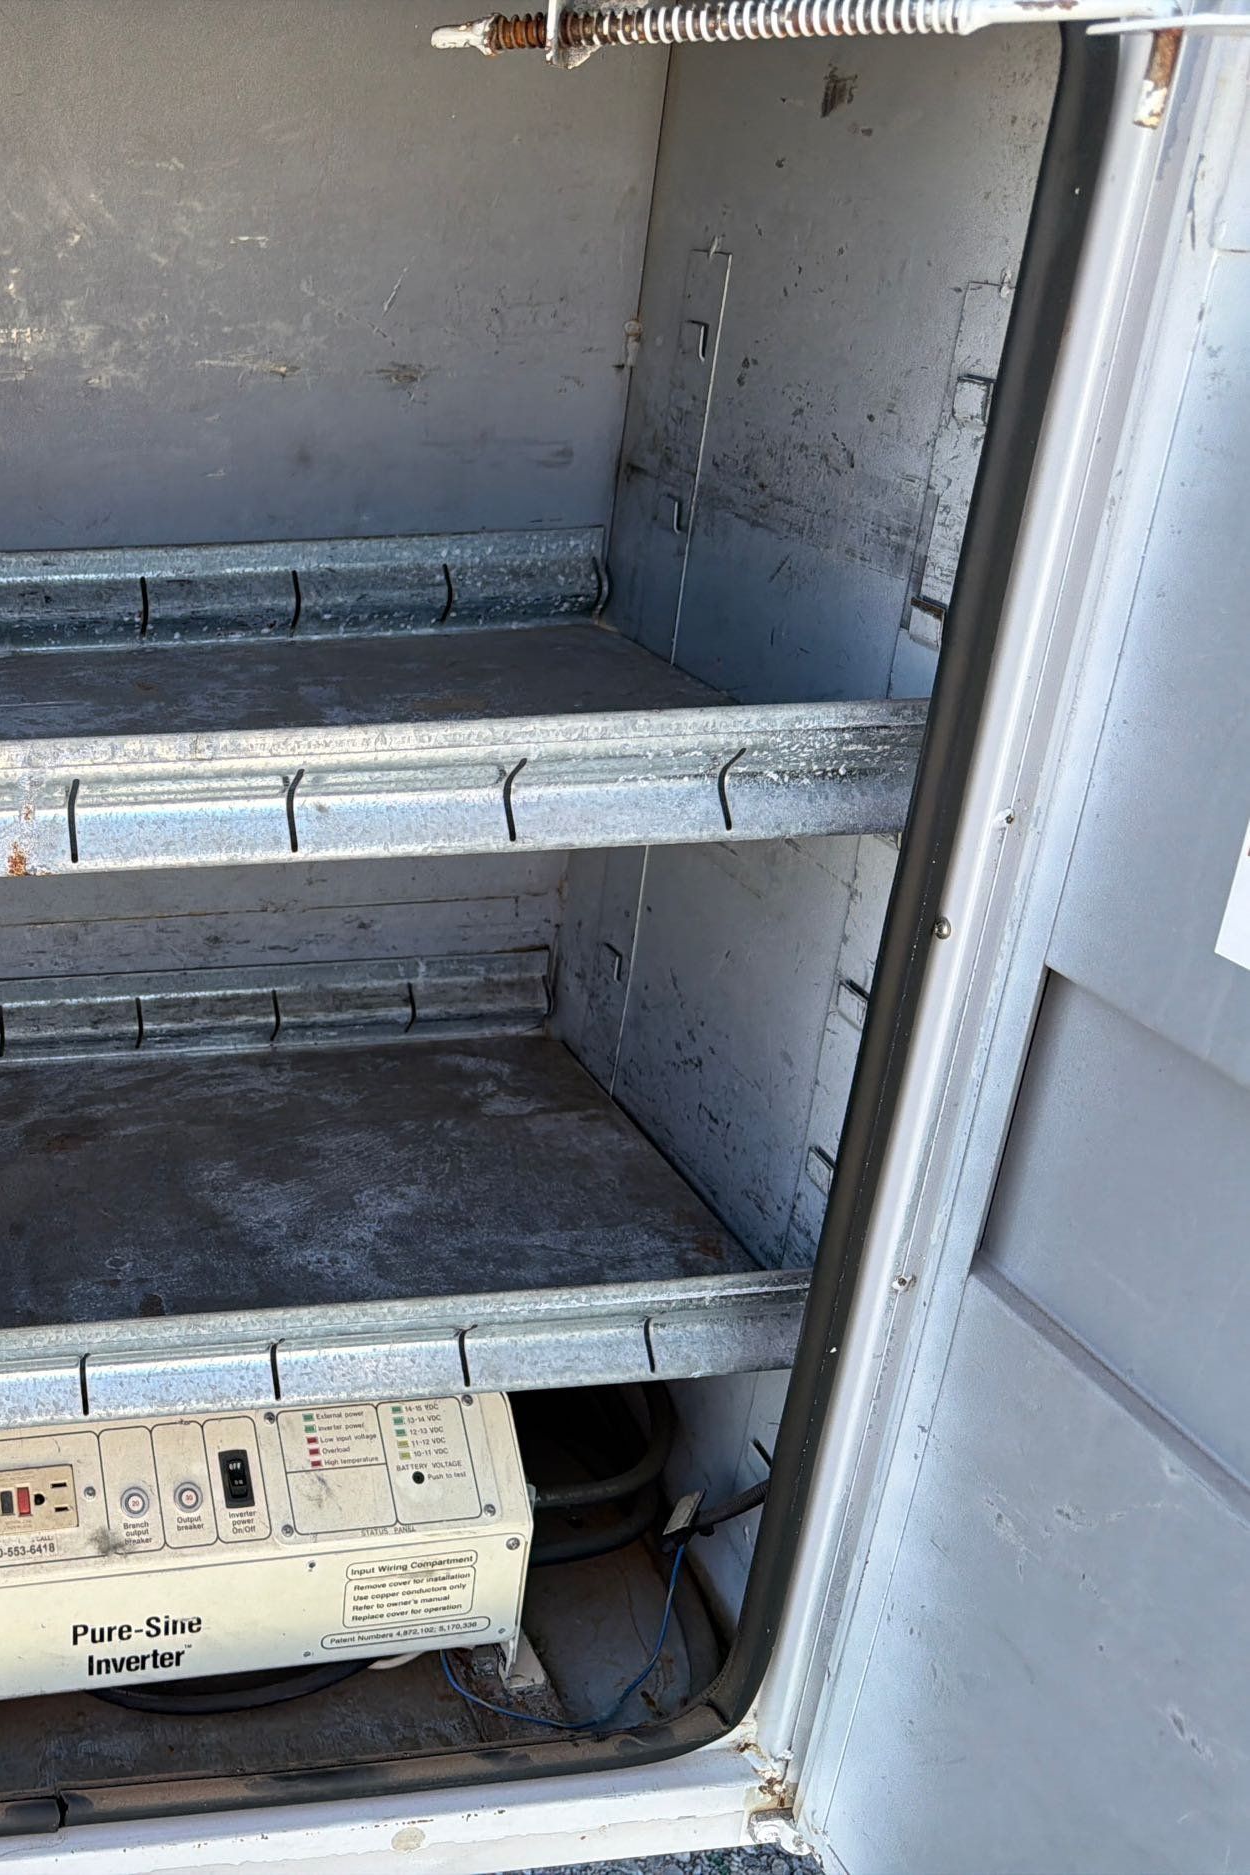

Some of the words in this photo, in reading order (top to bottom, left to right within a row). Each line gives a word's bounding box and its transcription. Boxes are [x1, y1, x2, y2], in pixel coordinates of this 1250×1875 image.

[424, 1403, 439, 1411] VDC
[345, 1410, 364, 1418] power
[345, 1422, 365, 1431] power
[320, 1436, 334, 1444] Low
[336, 1434, 352, 1443] input
[354, 1433, 377, 1441] voltage
[411, 1439, 430, 1447] 11-12
[322, 1446, 350, 1454] Overload
[413, 1449, 432, 1457] 10-11
[434, 1447, 449, 1455] VDC
[324, 1458, 340, 1467] High
[340, 1455, 379, 1465] temperature
[396, 1462, 428, 1471] BATTERY
[431, 1460, 462, 1468] VOLTAGE
[427, 1472, 444, 1480] Push
[445, 1471, 452, 1479] to
[229, 1510, 256, 1519] Inverter
[177, 1515, 202, 1524] Output
[232, 1518, 255, 1527] power
[123, 1521, 149, 1530] Branch
[177, 1523, 204, 1532] breaker
[126, 1529, 149, 1538] output
[361, 1527, 390, 1537] STATUS
[351, 1567, 375, 1577] Input
[378, 1563, 408, 1573] Wiring
[410, 1555, 473, 1569] Compartment
[353, 1583, 387, 1592] Remove
[388, 1580, 410, 1588] cover
[426, 1572, 471, 1583] installation
[353, 1594, 369, 1602] Use
[371, 1591, 399, 1601] copper
[401, 1585, 447, 1596] conductors
[449, 1582, 467, 1591] only
[352, 1603, 374, 1612] Refer
[376, 1602, 385, 1610] to
[386, 1598, 419, 1609] owner's
[420, 1594, 450, 1604] manual
[352, 1612, 385, 1622] Replace
[386, 1610, 409, 1618] cover
[411, 1607, 422, 1615] for
[423, 1602, 463, 1615] operation
[72, 1615, 203, 1646] Pure-Sine
[330, 1635, 356, 1645] Patent
[357, 1631, 394, 1642] Numbers
